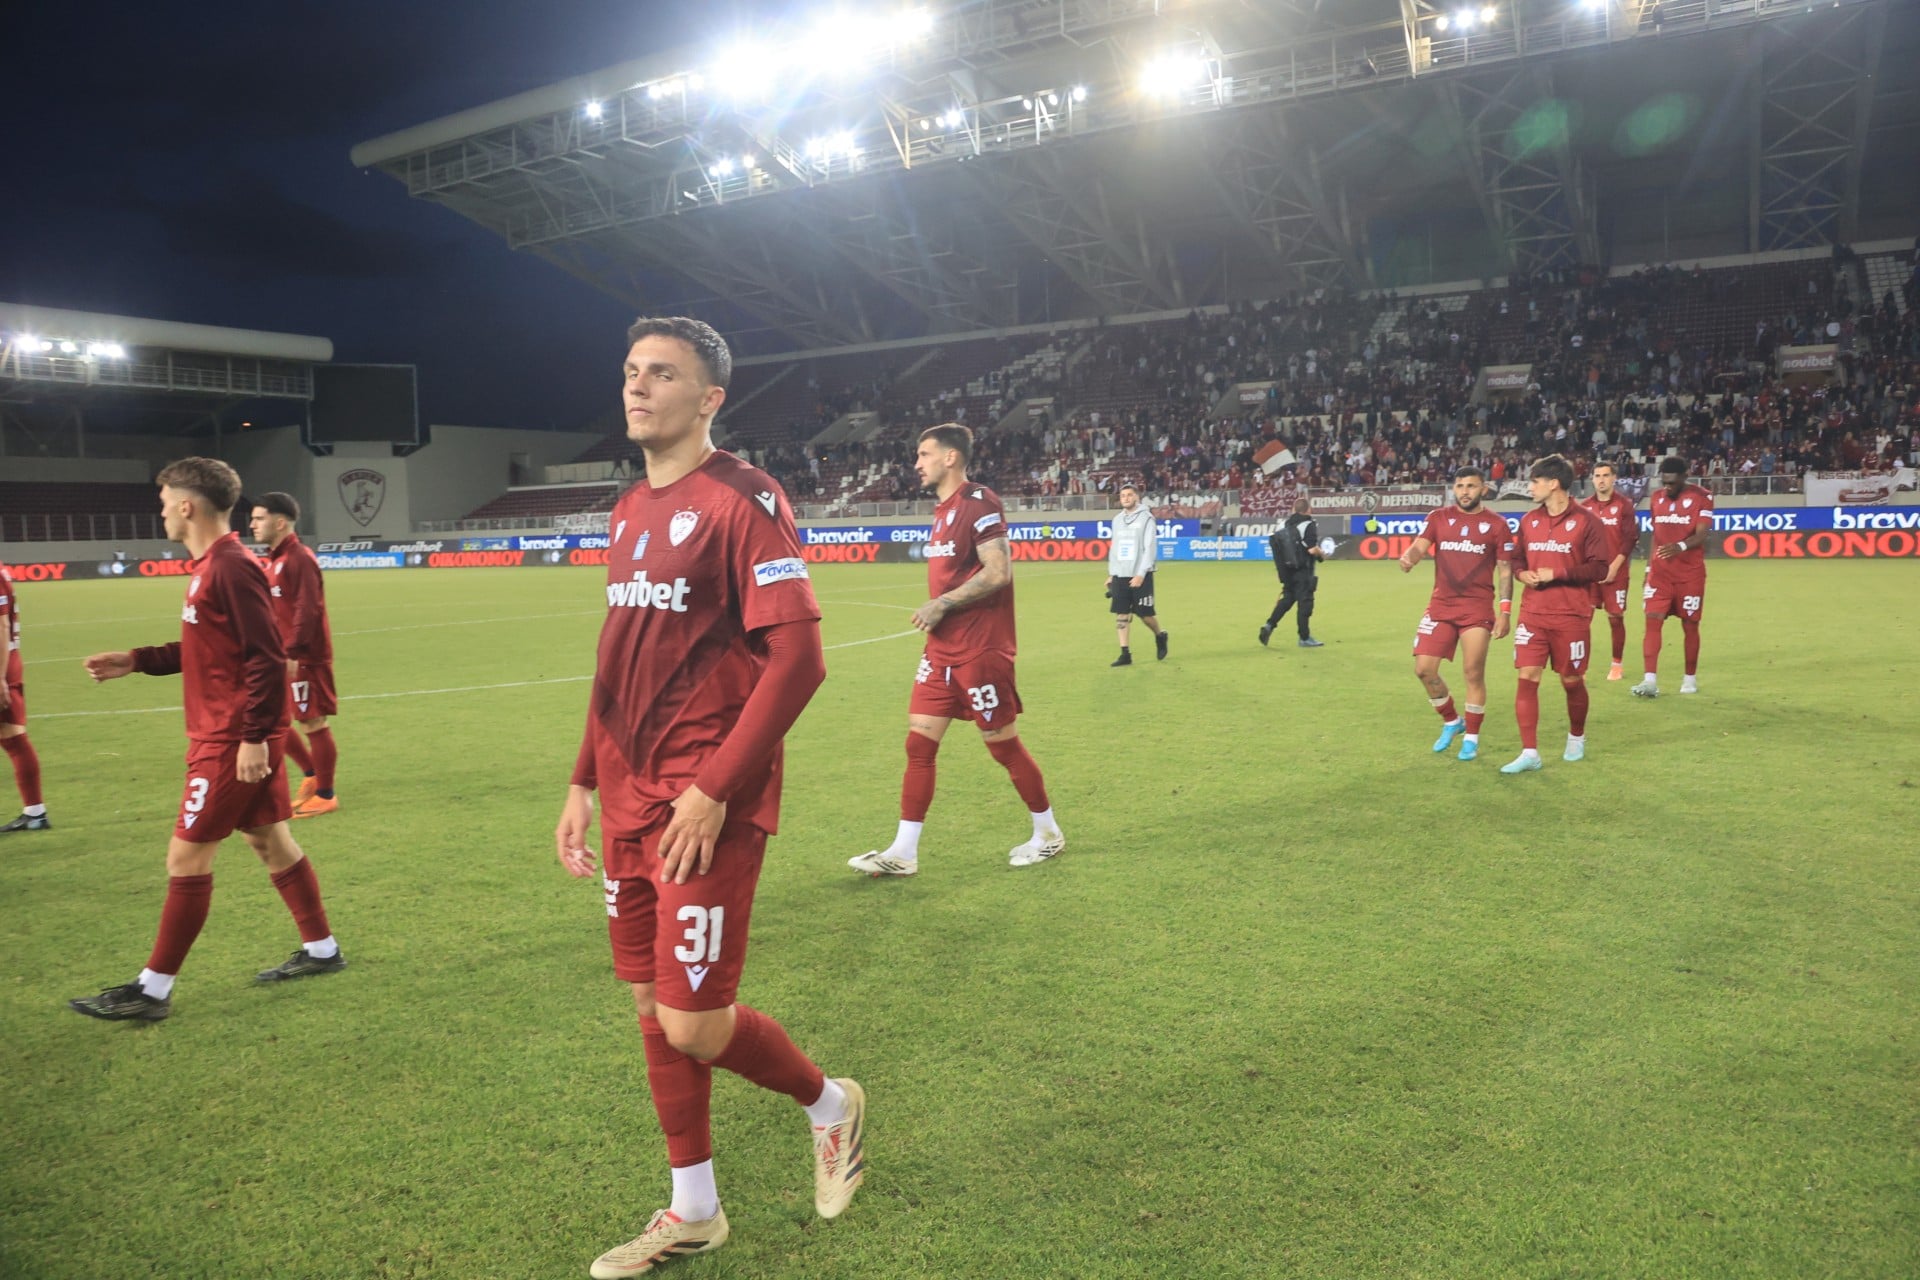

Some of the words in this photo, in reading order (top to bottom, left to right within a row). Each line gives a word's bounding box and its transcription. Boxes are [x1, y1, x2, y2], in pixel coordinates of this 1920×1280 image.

[1782, 355, 1833, 368] novibet
[1311, 496, 1355, 508] CRIMSON
[1382, 494, 1442, 507] DEFENDERS
[1655, 514, 1691, 525] novibet
[1832, 506, 1920, 529] brav
[519, 535, 567, 550] bravair
[806, 526, 874, 544] bravair
[318, 541, 373, 552] ETEM
[389, 541, 443, 553] novibet
[1439, 540, 1486, 554] novibet
[1528, 540, 1572, 553] novibet
[317, 555, 397, 569] Stoiximan
[1682, 595, 1700, 611] 28
[1569, 640, 1586, 661] 10
[291, 680, 309, 702] 17
[967, 683, 999, 711] 33
[184, 777, 210, 813] 3
[673, 904, 725, 963] 31
